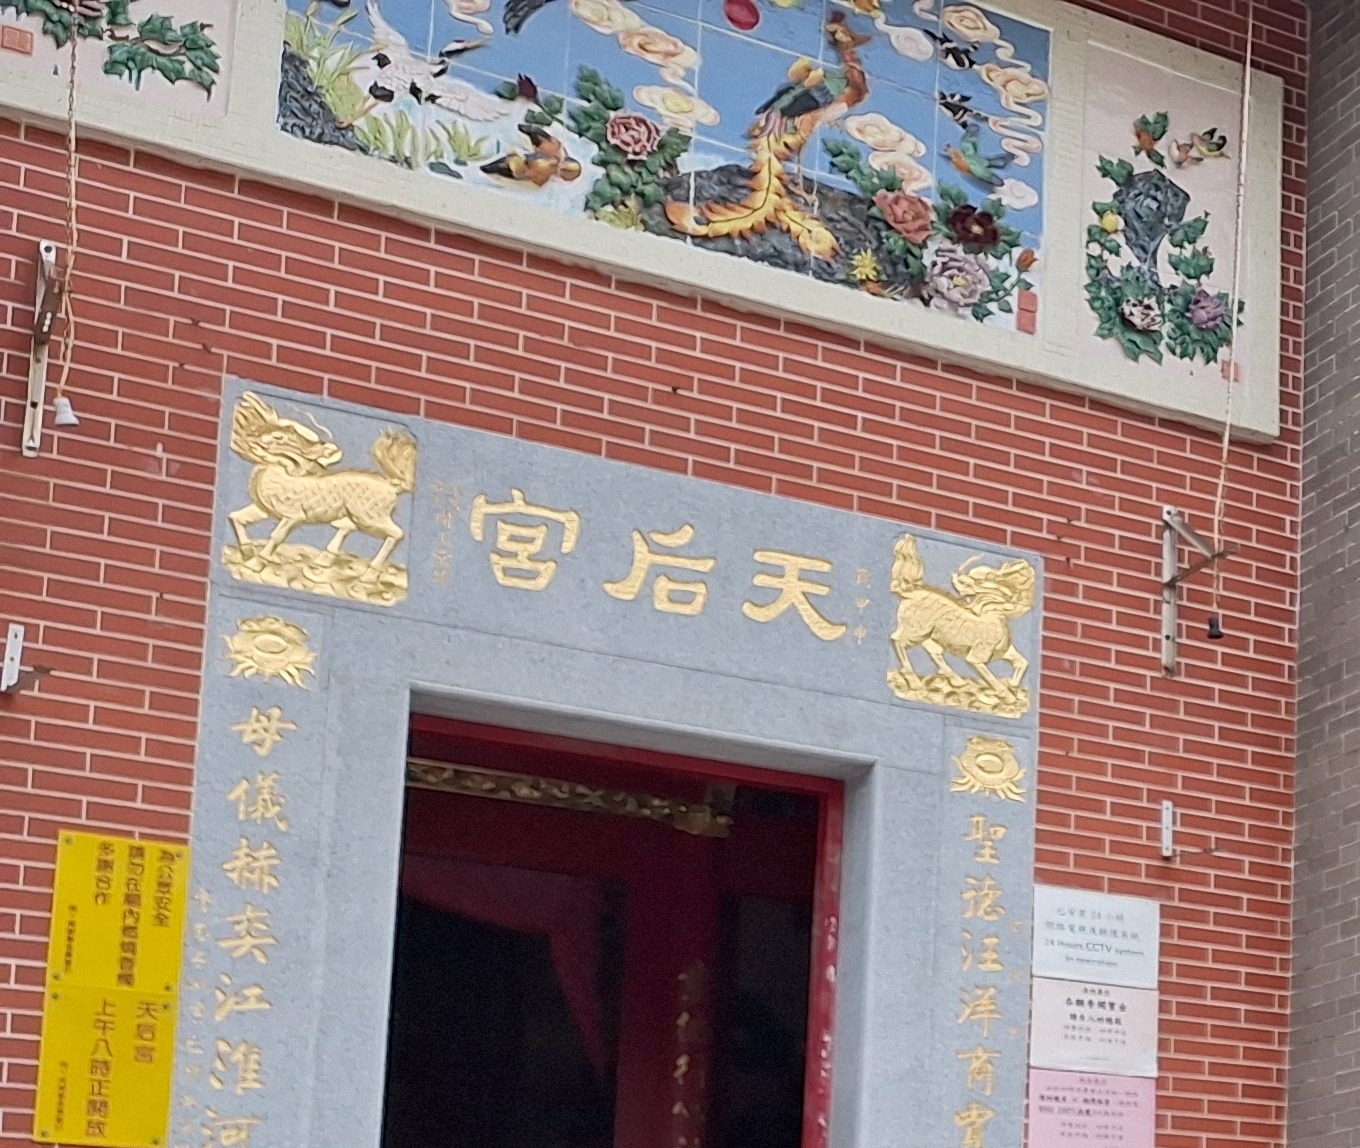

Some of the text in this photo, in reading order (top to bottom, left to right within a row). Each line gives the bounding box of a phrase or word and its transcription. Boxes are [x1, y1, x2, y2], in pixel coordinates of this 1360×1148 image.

[469, 487, 848, 643] 天后宮
[1086, 942, 1112, 953] CCTV
[133, 1000, 161, 1064] 天后宮
